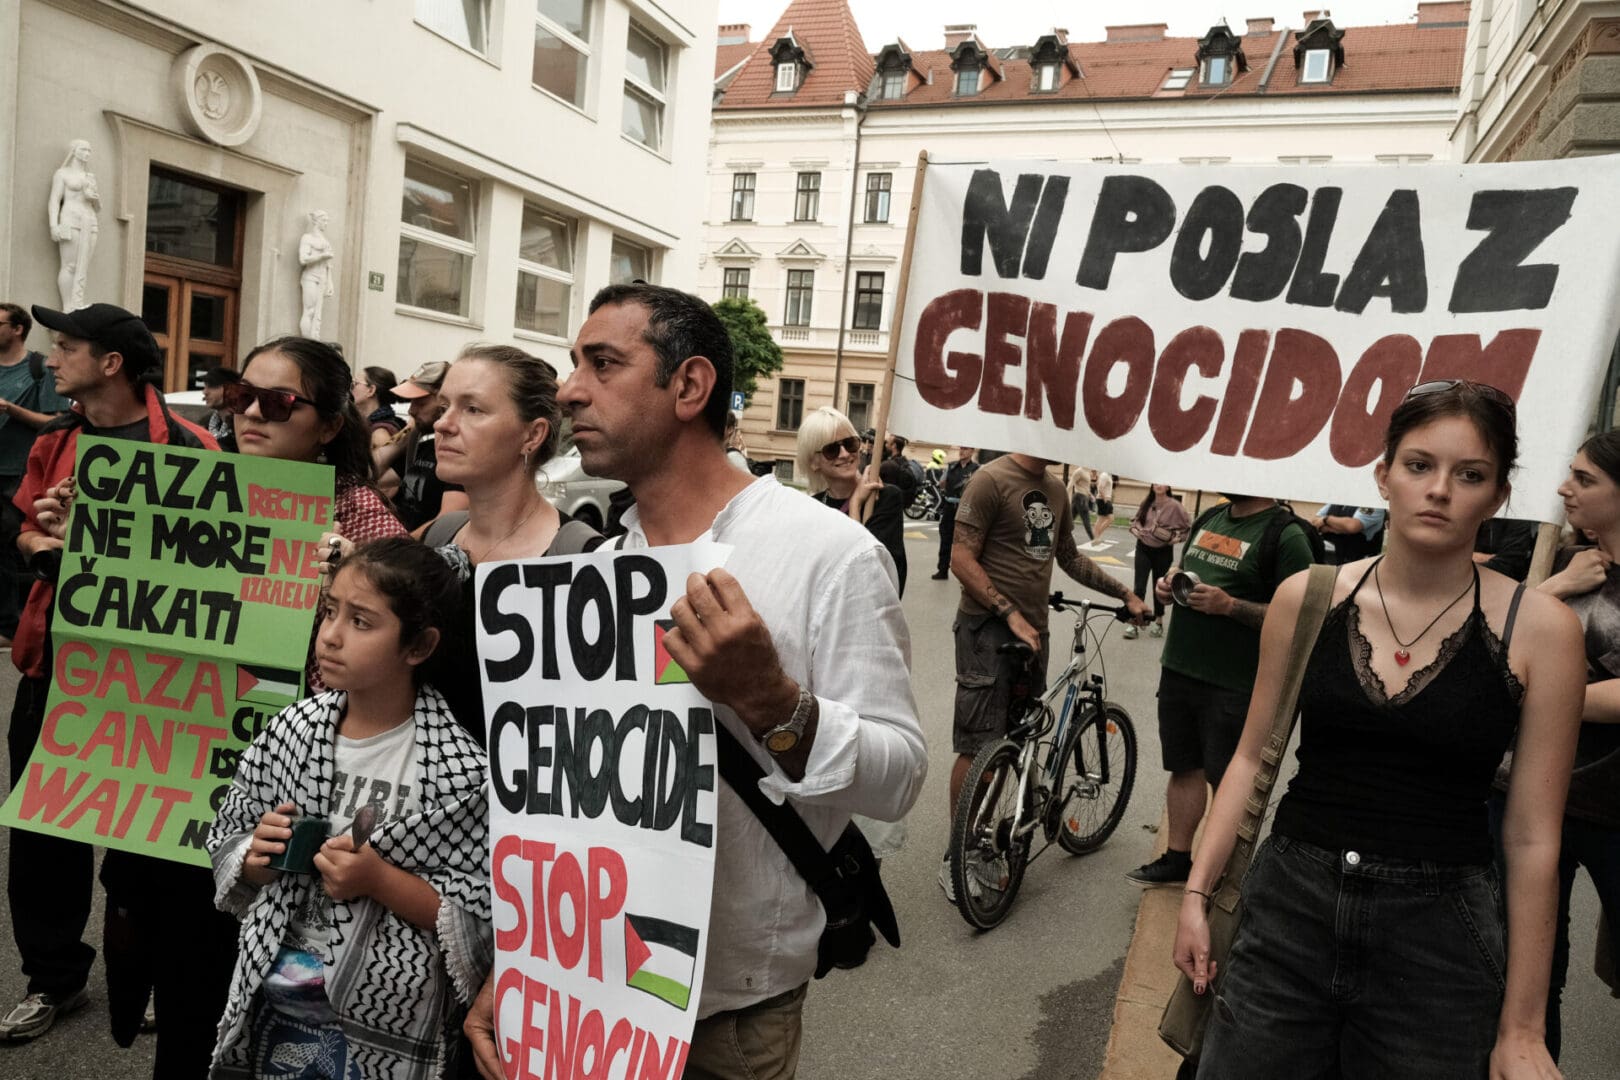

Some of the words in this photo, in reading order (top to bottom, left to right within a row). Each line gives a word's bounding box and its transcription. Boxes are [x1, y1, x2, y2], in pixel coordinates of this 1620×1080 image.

[960, 169, 1071, 280] NI
[1075, 174, 1428, 314] POSLA
[1448, 186, 1580, 314] Z
[77, 444, 244, 514] GAZA
[247, 483, 331, 525] RECITE
[68, 503, 136, 559] NE
[150, 514, 271, 575] MORE
[268, 538, 320, 579] NE
[58, 555, 242, 645] ČAKATI
[240, 576, 320, 610] IZRAELU
[479, 554, 668, 683] STOP
[54, 640, 227, 718] GAZA
[41, 701, 228, 780] CAN'T
[489, 701, 715, 848] GENOCIDE
[17, 762, 194, 843] WAIT
[331, 770, 413, 825] GIRL
[492, 834, 628, 983] STOP
